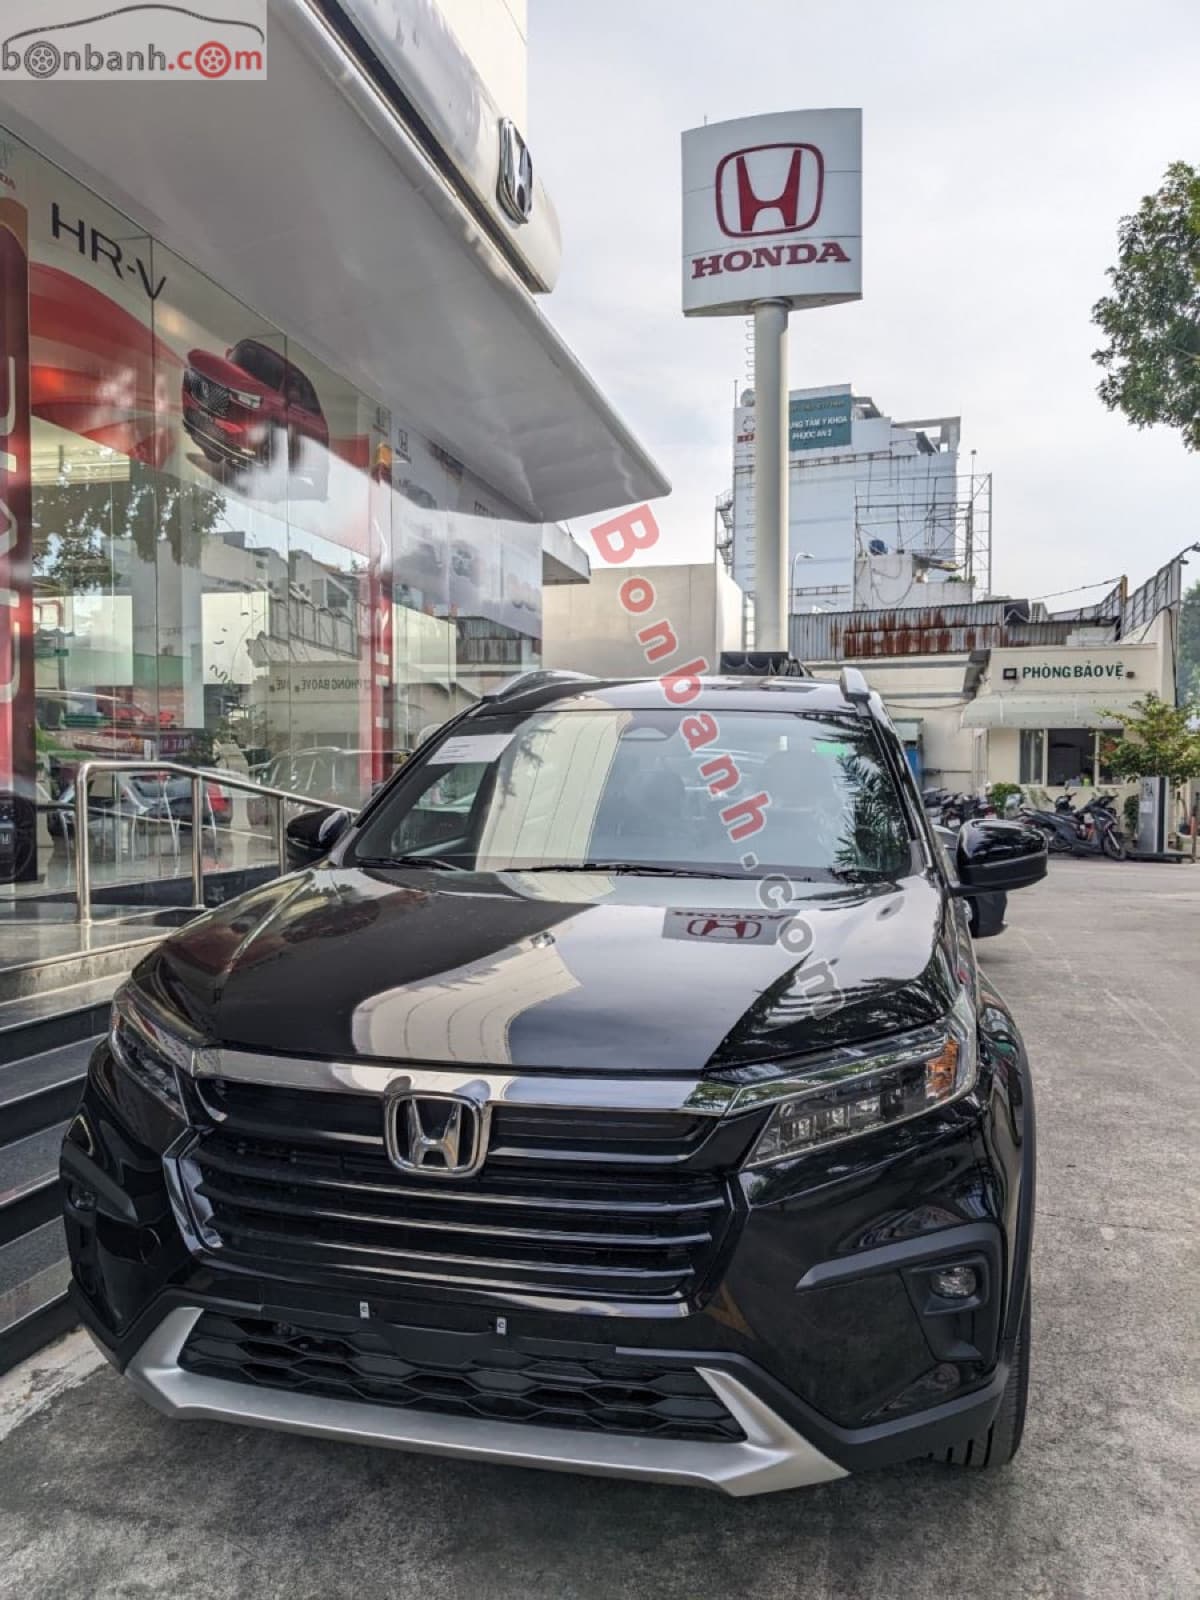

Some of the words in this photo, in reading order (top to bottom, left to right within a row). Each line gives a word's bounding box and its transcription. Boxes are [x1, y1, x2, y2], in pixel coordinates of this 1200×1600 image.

[52, 202, 166, 300] HR-V
[691, 242, 851, 279] HONDA
[1022, 662, 1071, 679] PHÒNG
[1073, 660, 1104, 678] BẢO
[1105, 661, 1124, 680] VỆ
